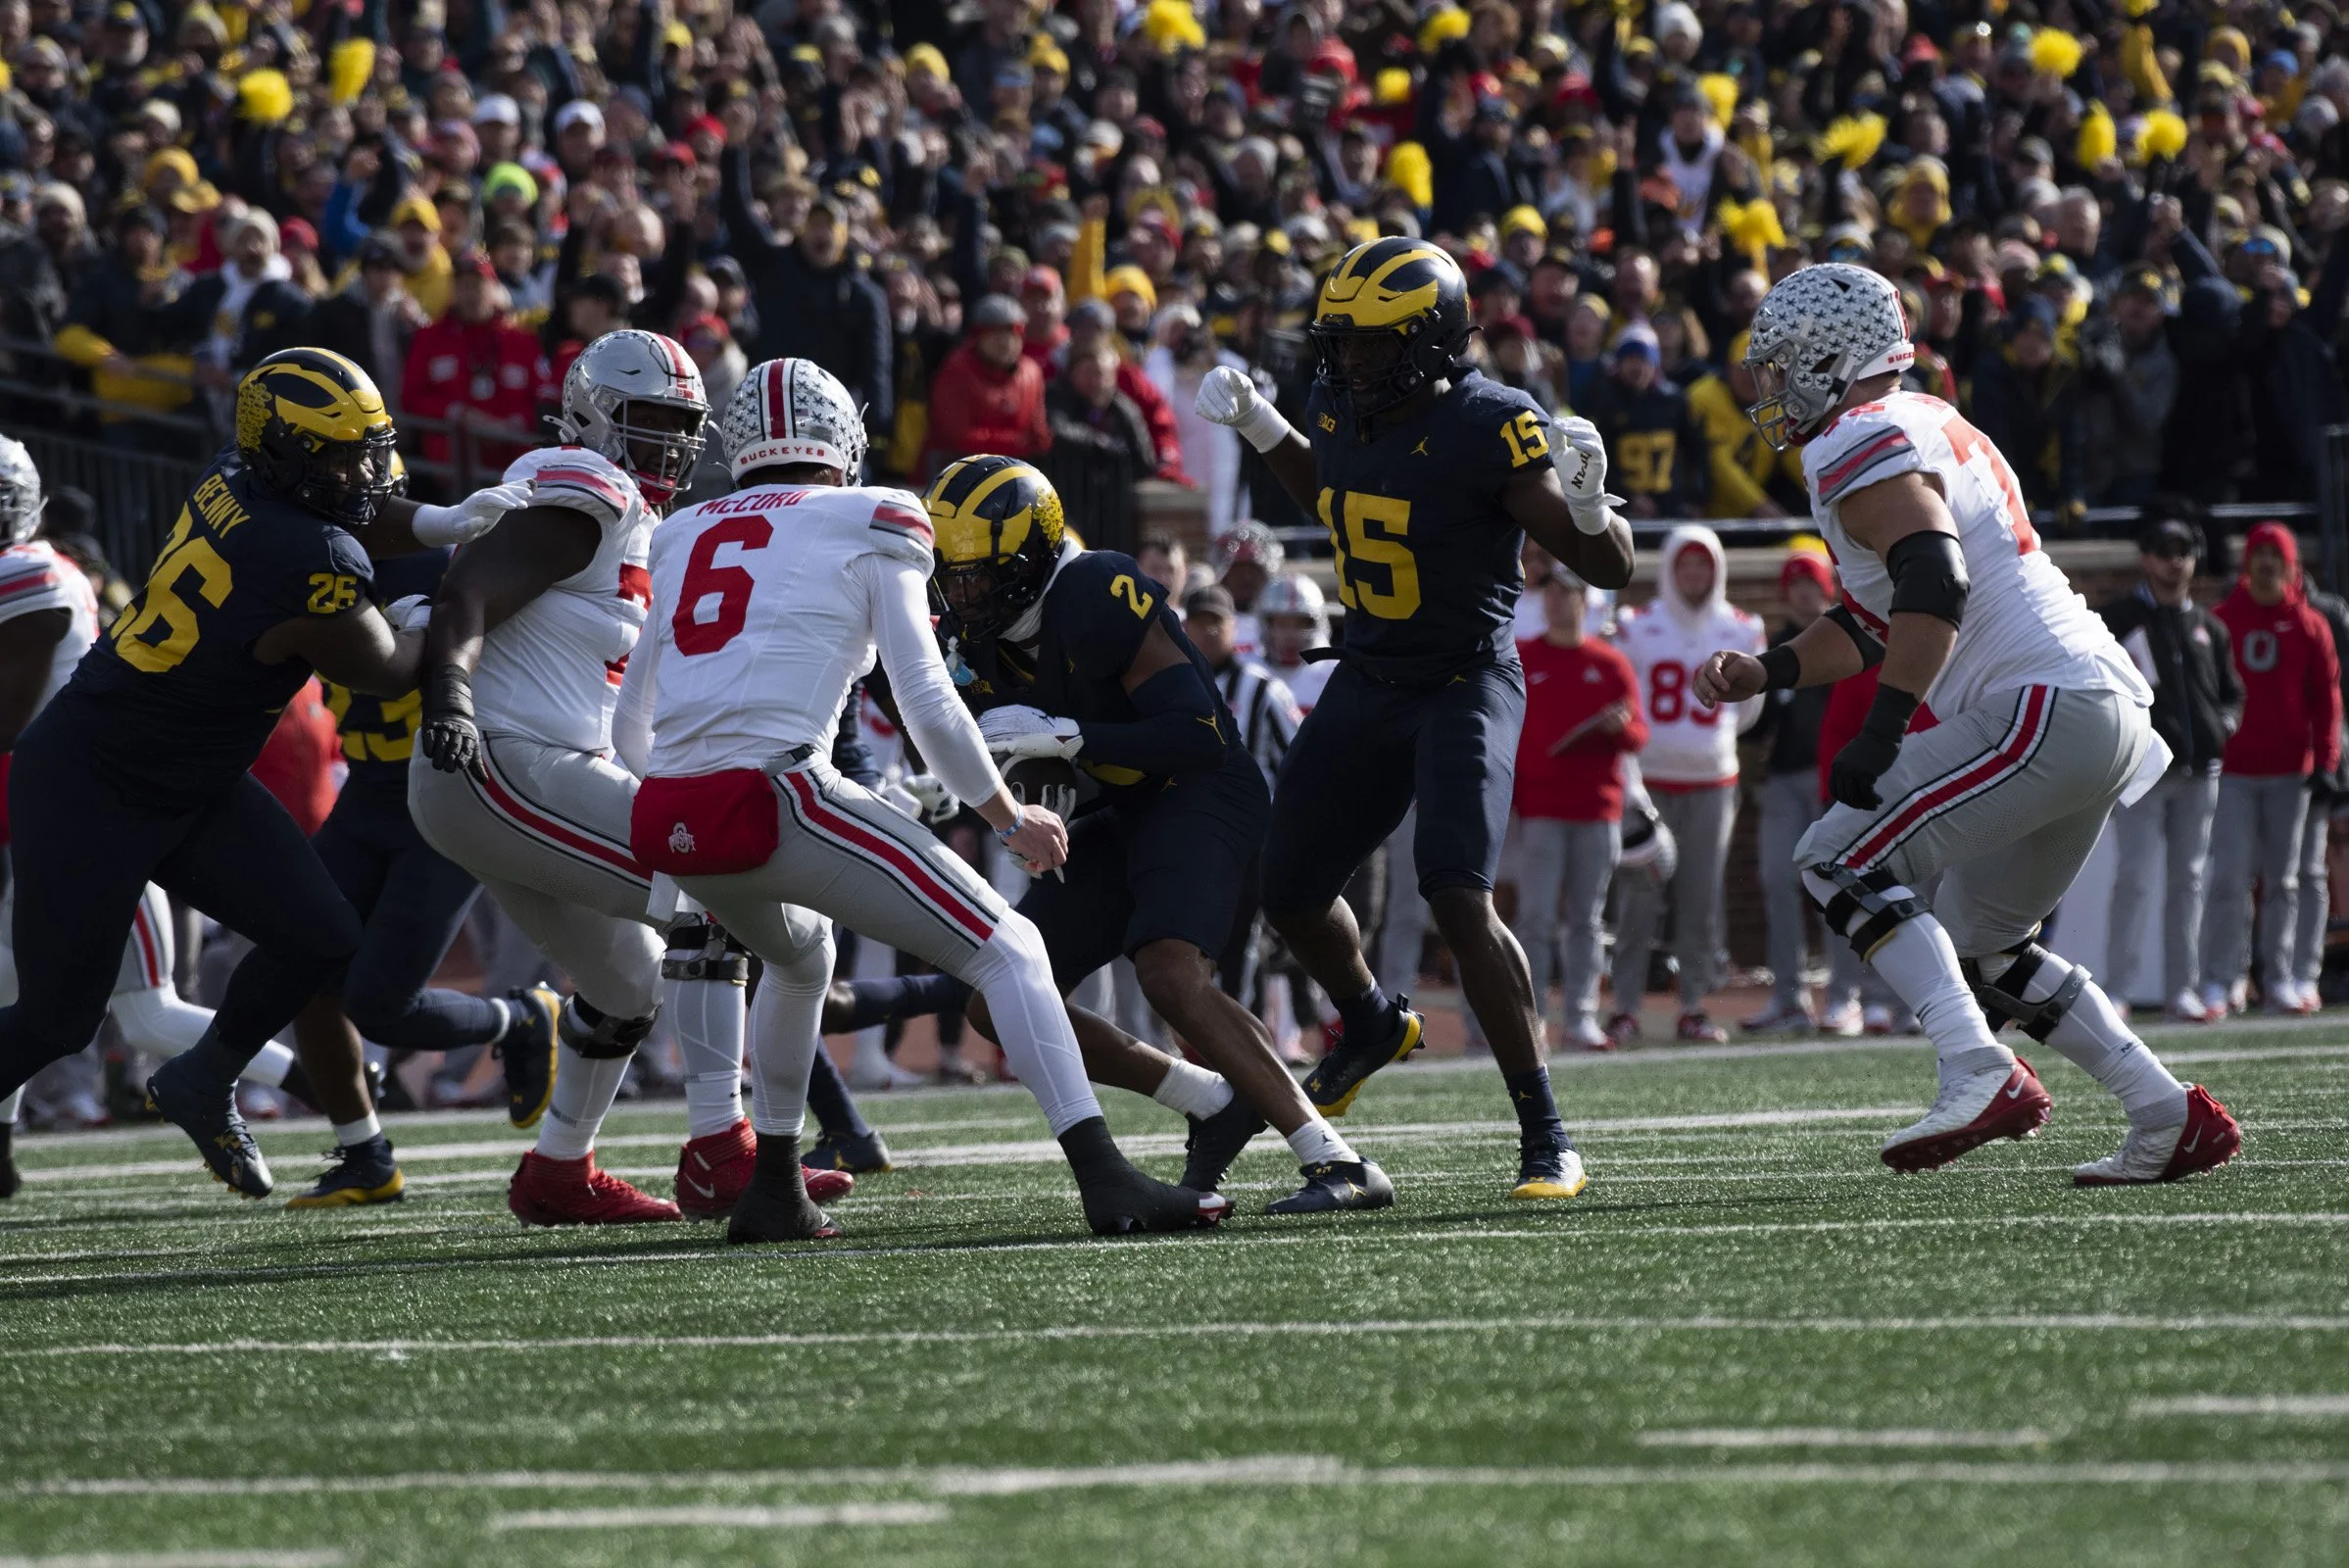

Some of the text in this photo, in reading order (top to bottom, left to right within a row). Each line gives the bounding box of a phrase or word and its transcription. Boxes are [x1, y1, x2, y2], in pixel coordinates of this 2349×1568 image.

[740, 445, 826, 466] BUCKEYES
[1499, 410, 1549, 468] 15
[1615, 428, 1677, 493] 97
[193, 473, 251, 539] BENNY
[1316, 486, 1421, 620] 15
[307, 572, 357, 614] 26
[672, 514, 774, 658] 6
[1109, 573, 1154, 619] 2
